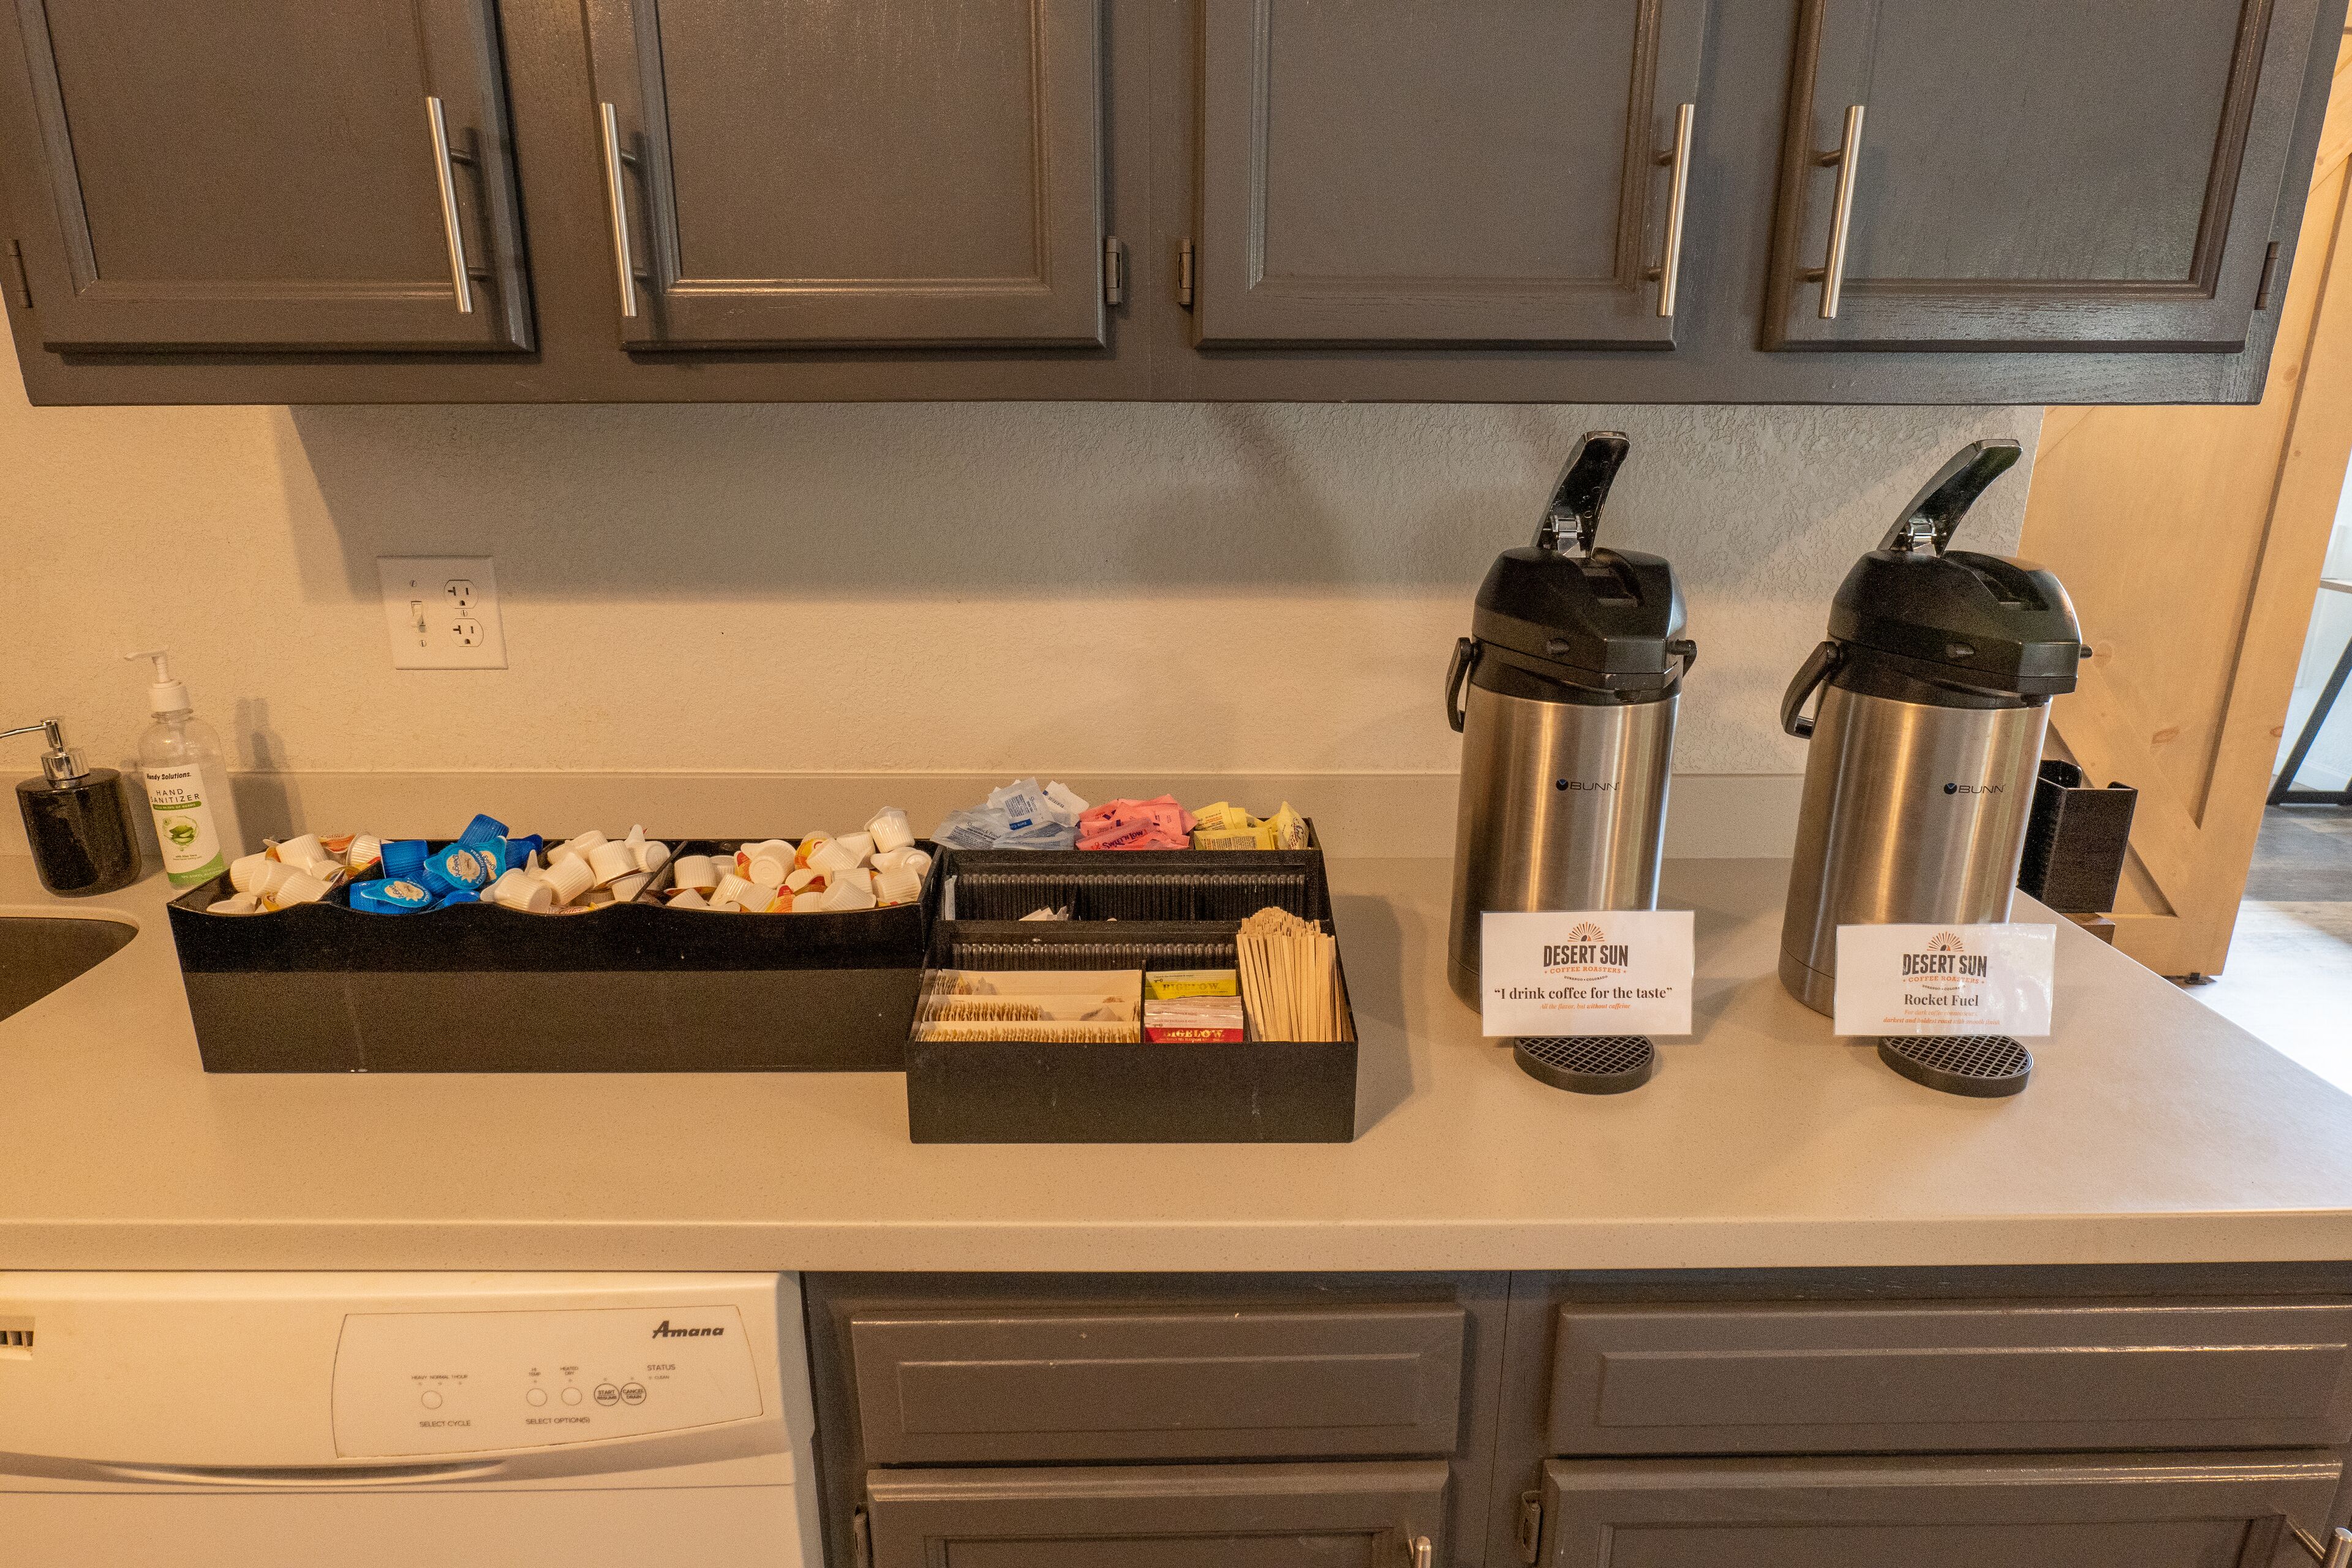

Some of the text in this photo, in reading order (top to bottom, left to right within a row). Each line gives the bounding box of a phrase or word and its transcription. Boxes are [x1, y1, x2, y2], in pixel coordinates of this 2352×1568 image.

[1570, 781, 1618, 791] BUNN
[1958, 785, 2004, 794] BUNN
[150, 793, 200, 804] SANITIZER
[1544, 945, 1629, 967] DESERT SUN
[1902, 954, 1988, 978] DESERT SUN
[1941, 976, 1980, 984] ROASTERS
[1509, 987, 1545, 1000] drink
[1548, 987, 1587, 999] coffee
[1591, 987, 1609, 998] for
[1613, 987, 1633, 998] the
[1904, 994, 1978, 1006] Rocket Fuel
[1163, 1029, 1223, 1038] BIGELOW
[651, 1320, 725, 1340] Amana
